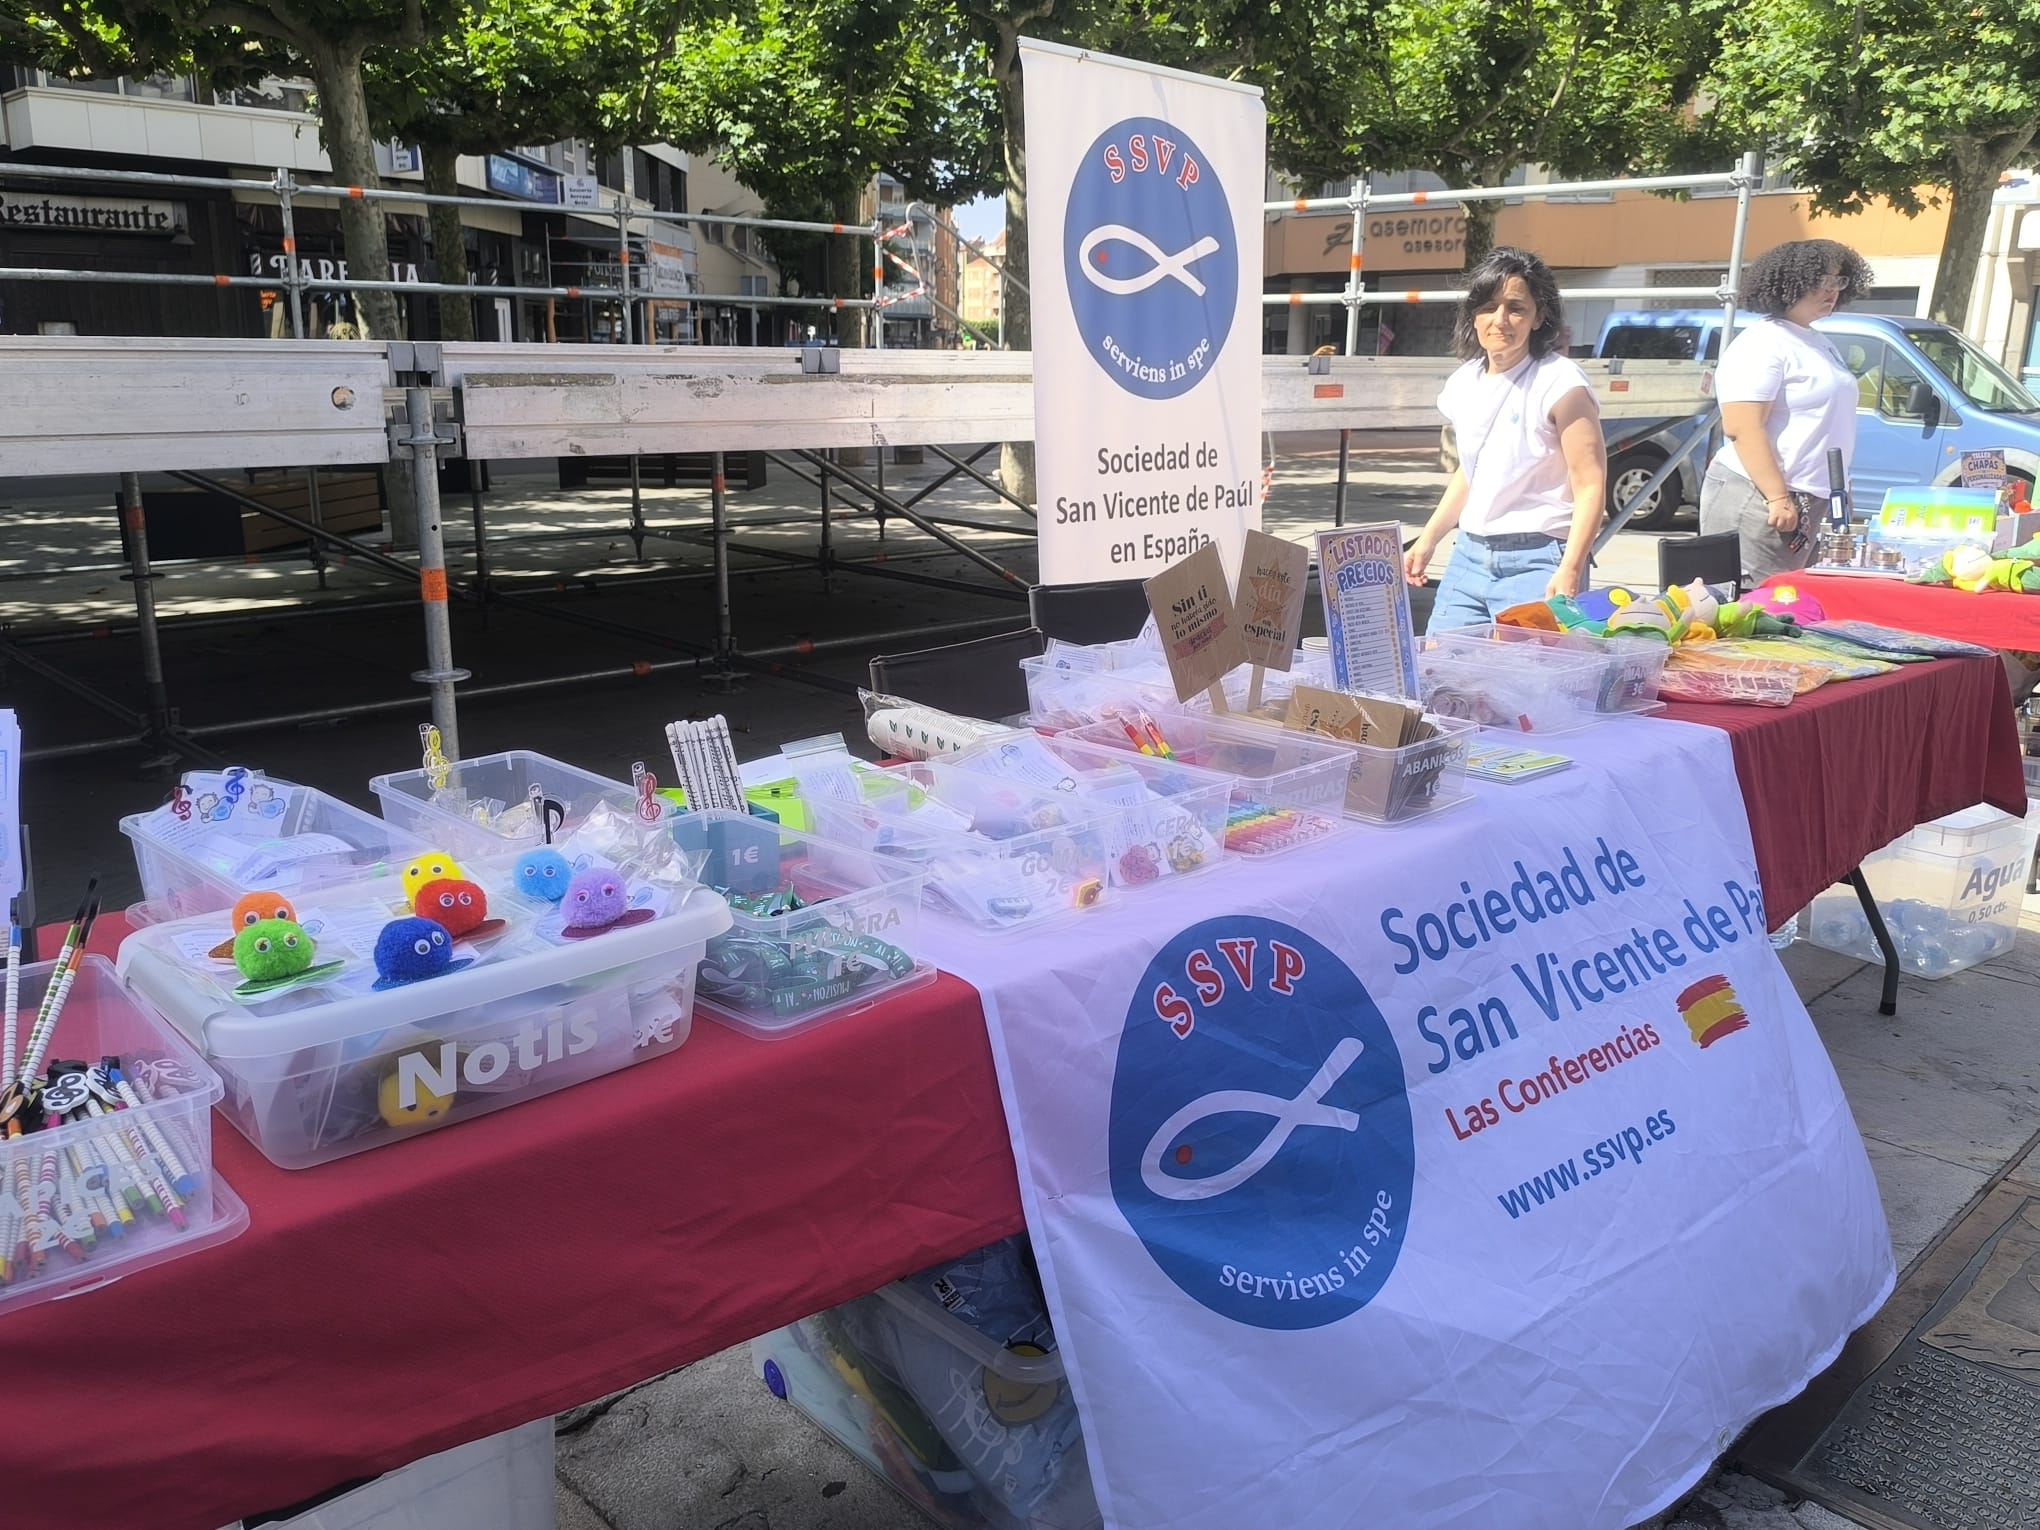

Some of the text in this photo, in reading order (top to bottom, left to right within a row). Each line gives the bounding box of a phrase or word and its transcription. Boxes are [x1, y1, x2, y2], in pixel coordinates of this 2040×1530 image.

[1104, 134, 1200, 191] SSVP
[1102, 333, 1210, 384] serviens in spe
[1097, 440, 1219, 475] Sociedad de
[1968, 460, 1999, 471] CHAPAS
[1056, 480, 1253, 525] San Vicente de Paúl
[1110, 528, 1210, 564] en España
[1333, 535, 1391, 565] LISTADO
[1337, 560, 1394, 593] PRECIOS
[1172, 585, 1208, 616] Sin ti
[1175, 607, 1218, 640] lo mismo
[1244, 622, 1286, 643] especial
[1632, 682, 1645, 696] 3€
[1402, 745, 1464, 777] ABANICOS
[732, 846, 759, 866] 1€
[1960, 858, 2025, 901] Agua
[1381, 836, 1646, 975] Sociedad de
[1968, 904, 1992, 924] 0,50
[813, 979, 851, 999] MUSIZON
[1154, 937, 1306, 1040] SSVP
[1418, 995, 1519, 1075] San
[1512, 930, 1686, 1022] Vicente
[1685, 904, 1740, 948] de
[398, 1008, 597, 1109] Notis
[1445, 1021, 1660, 1142] Las Conferencias
[1497, 1105, 1676, 1221] www.ssvp.es
[1219, 1188, 1393, 1302] serviens in spe
[1917, 1348, 1957, 1367] LOS
[1909, 1418, 1954, 1440] LOS
[1983, 1405, 2029, 1427] QUE
[1865, 1424, 1911, 1445] CON
[1916, 1444, 1961, 1466] LOS
[1964, 1465, 2013, 1488] QUE
[1957, 1450, 2030, 1483] SAYOS
[1944, 1469, 2021, 1503] SOBRE
